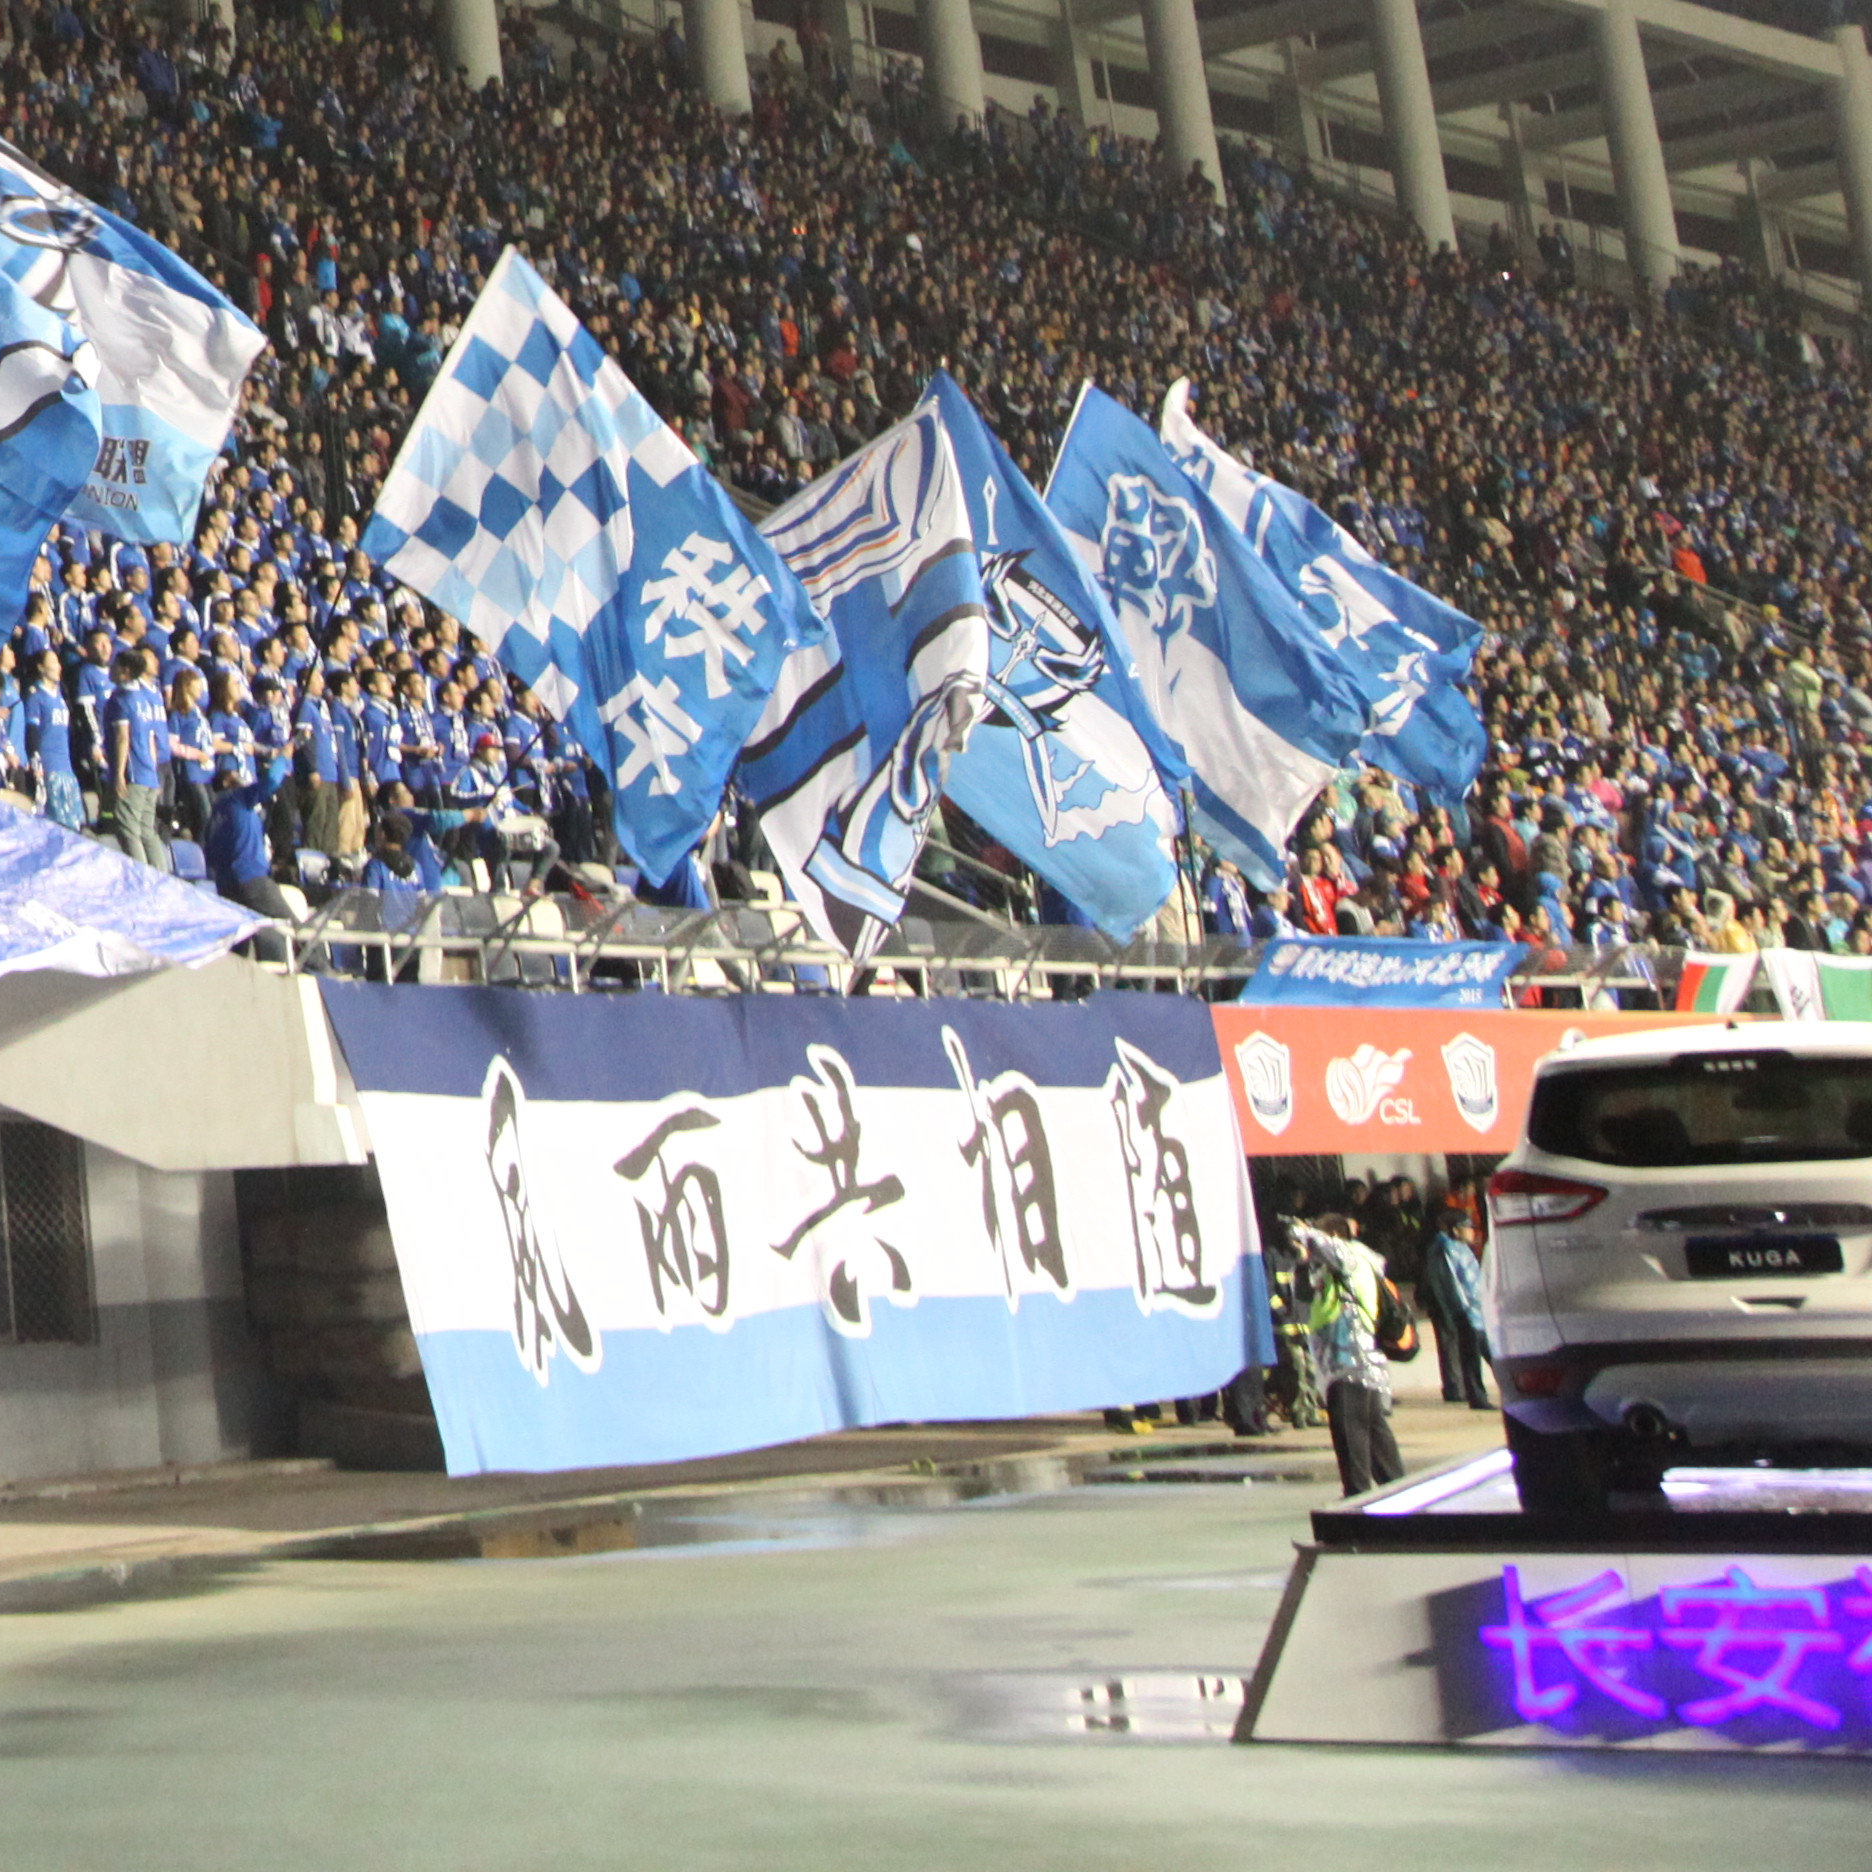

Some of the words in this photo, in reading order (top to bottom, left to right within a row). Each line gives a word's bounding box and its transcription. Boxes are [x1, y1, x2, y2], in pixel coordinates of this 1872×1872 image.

[1379, 1097, 1422, 1125] CSL
[1727, 1248, 1802, 1268] KUGA
[1478, 1563, 1872, 1730] 长安
